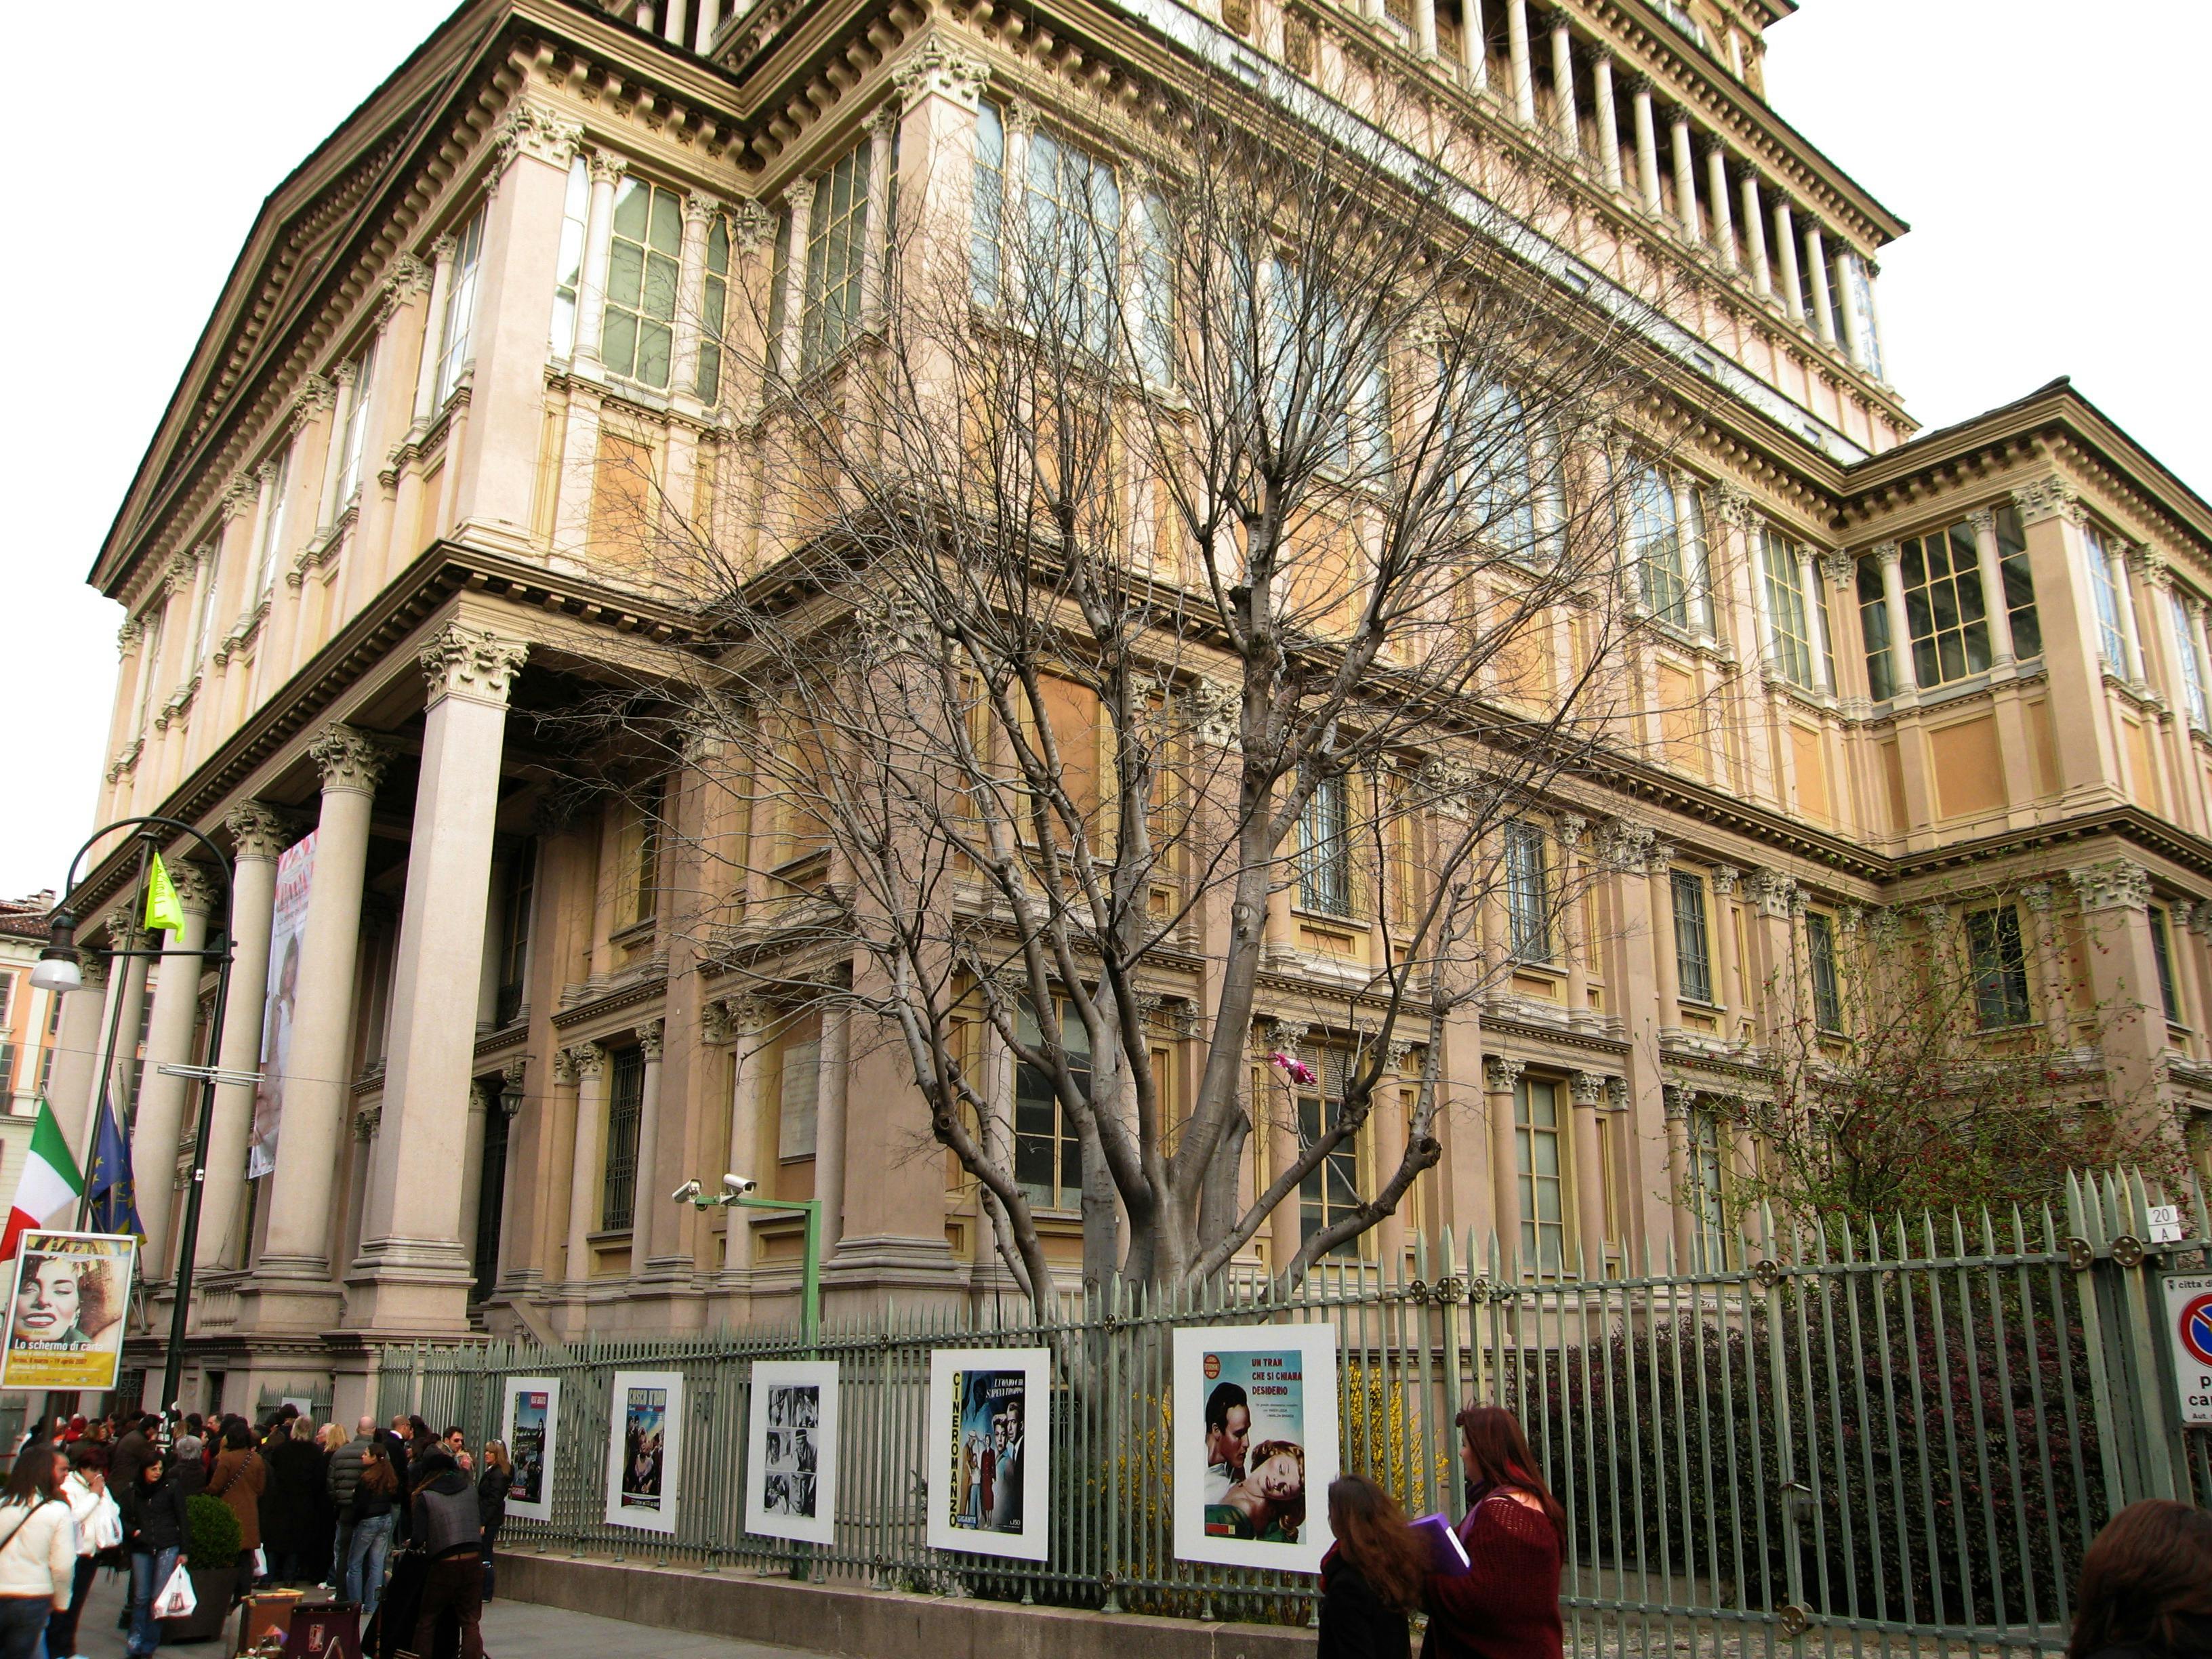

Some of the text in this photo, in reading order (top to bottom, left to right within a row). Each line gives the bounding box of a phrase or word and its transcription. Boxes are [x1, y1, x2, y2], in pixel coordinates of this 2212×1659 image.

[2152, 1208, 2170, 1223] 20
[2162, 1227, 2169, 1241] A
[14, 1338, 104, 1351] Lo schermo di carta
[1252, 1358, 1283, 1367] UN TRAM
[1252, 1372, 1302, 1380] CHE SI CHIAMA
[2200, 1376, 2212, 1389] p
[1252, 1386, 1288, 1395] DESIDERIO
[949, 1372, 961, 1528] CINEROMANZO
